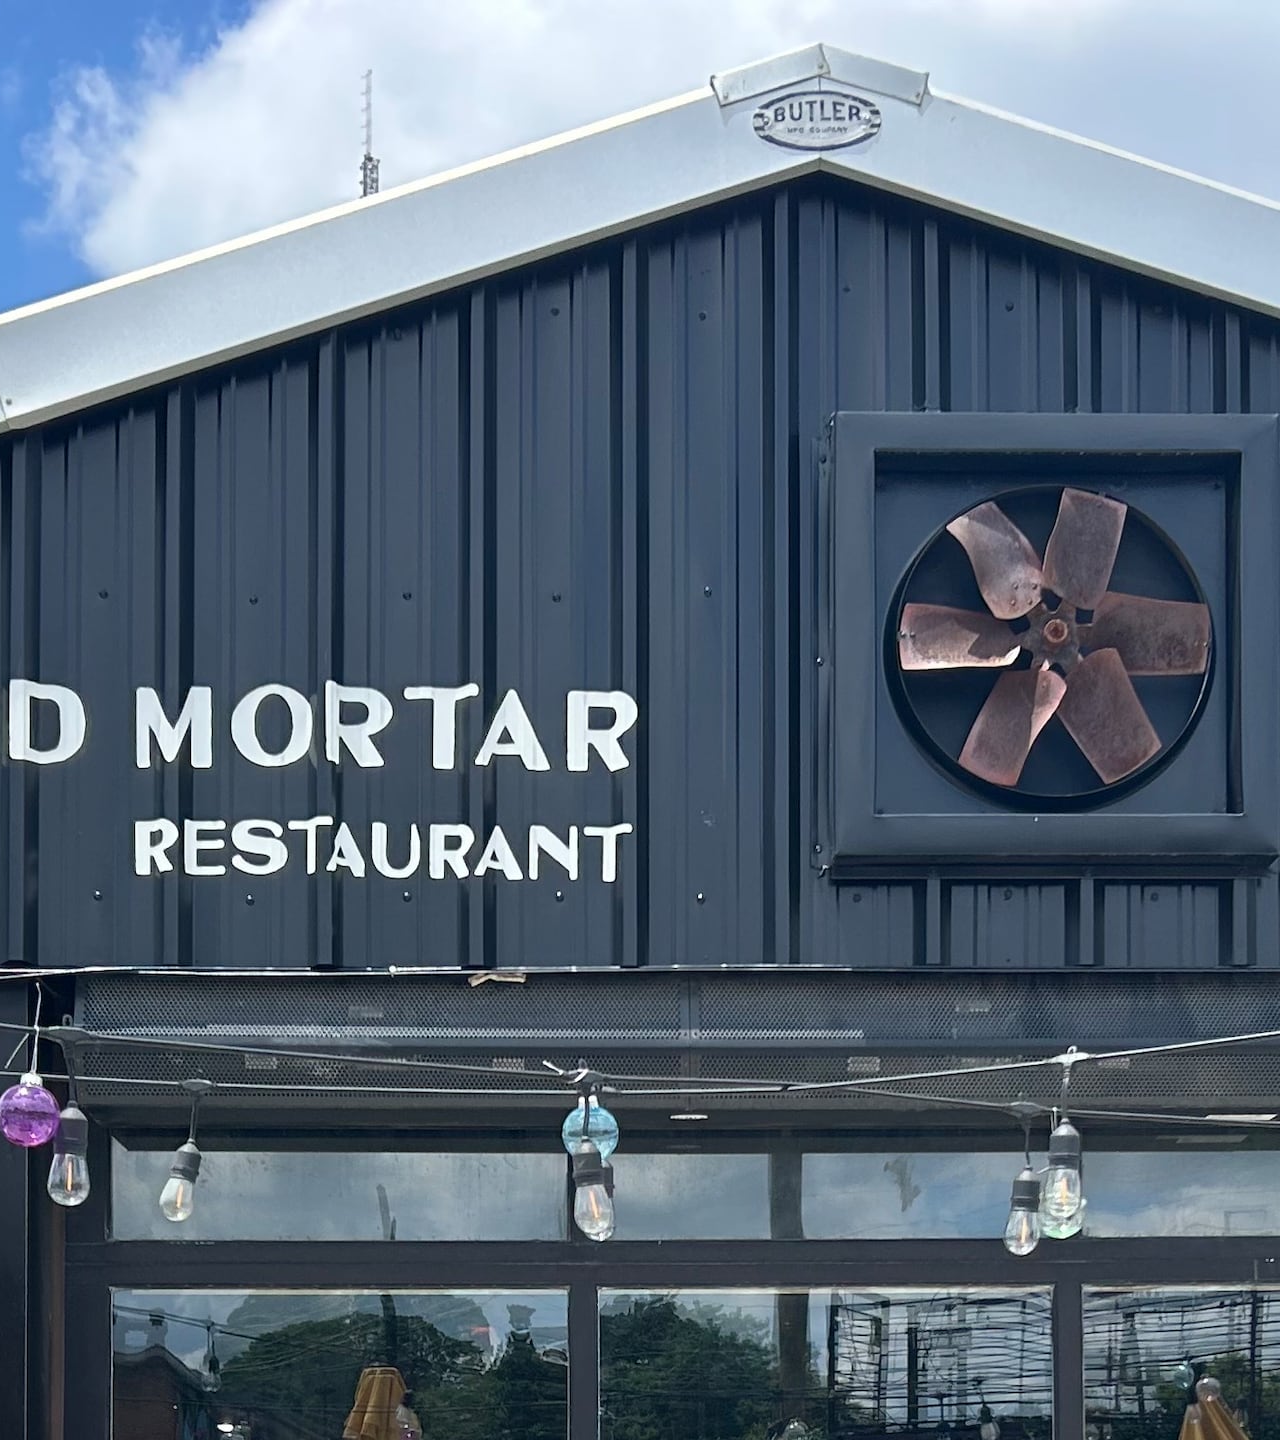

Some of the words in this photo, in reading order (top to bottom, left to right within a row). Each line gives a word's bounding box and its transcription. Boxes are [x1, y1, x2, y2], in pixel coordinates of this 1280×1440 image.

[773, 100, 861, 123] BUTLER
[135, 680, 638, 773] MORTAR
[135, 816, 633, 883] RESTAURANT
